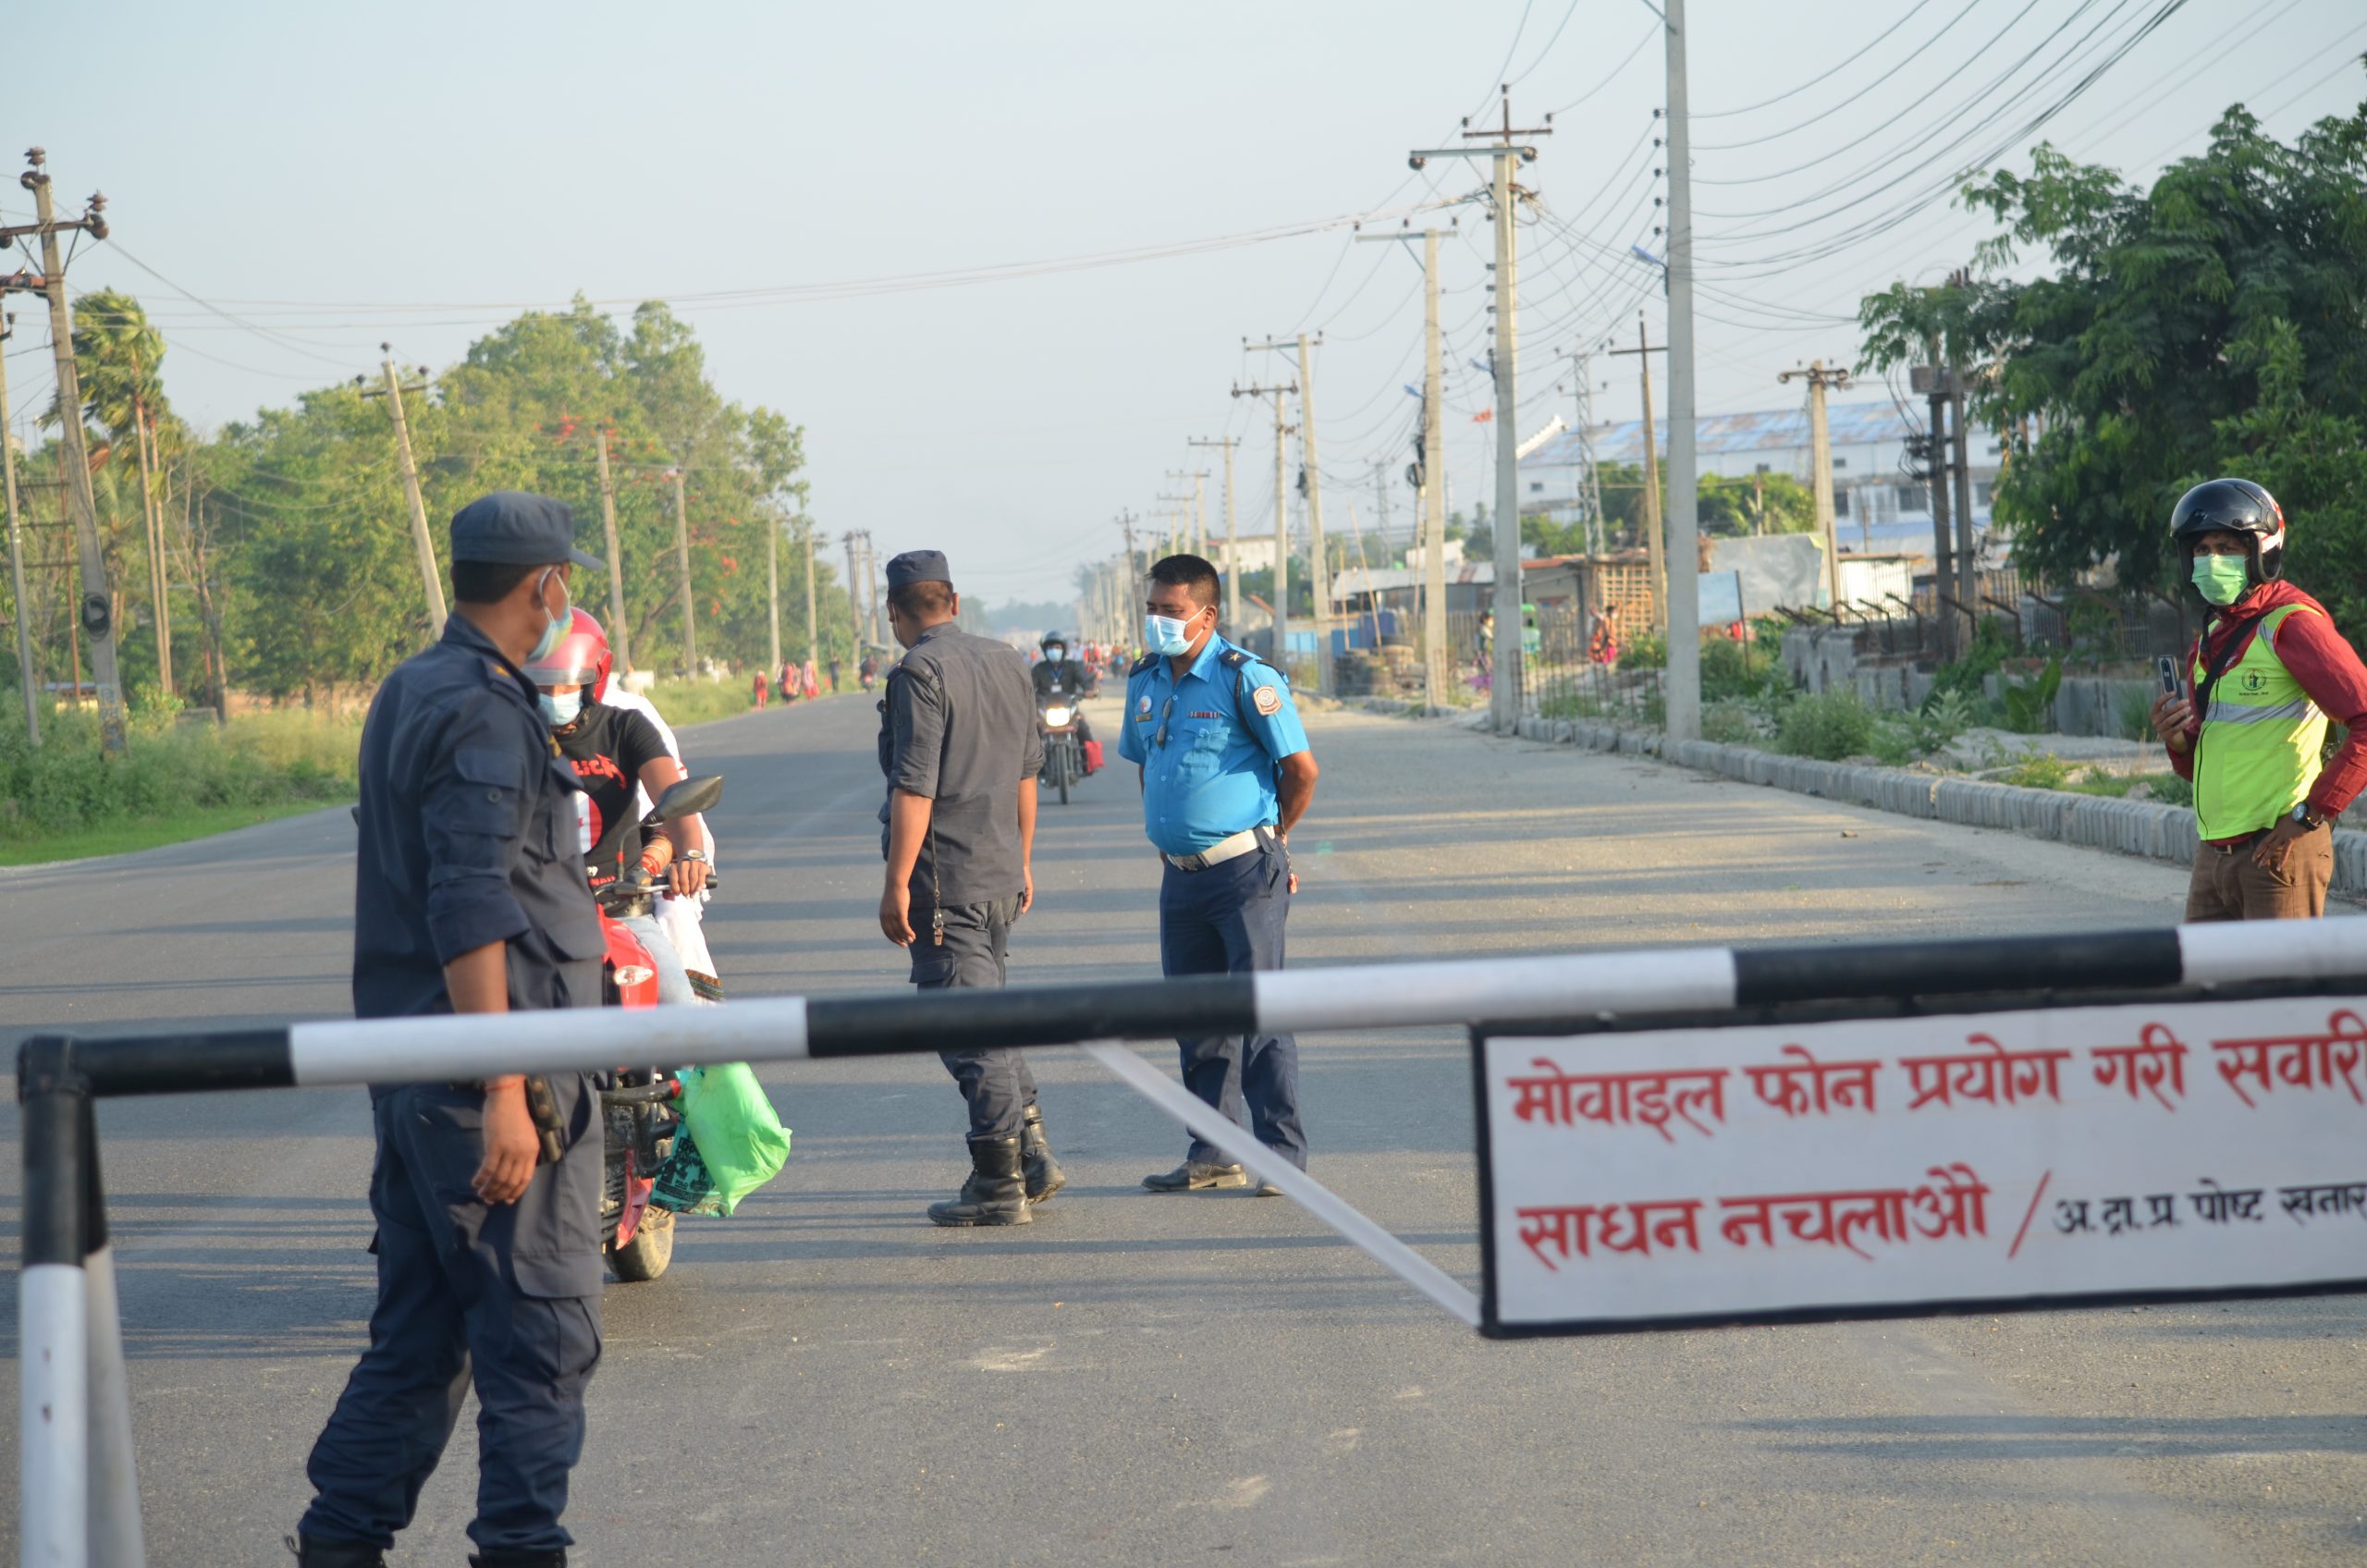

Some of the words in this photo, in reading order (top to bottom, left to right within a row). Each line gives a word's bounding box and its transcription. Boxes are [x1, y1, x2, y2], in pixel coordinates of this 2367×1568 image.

[1506, 1057, 1732, 1143] मोवाइल
[1743, 1044, 1883, 1117] फोन
[1898, 1033, 2073, 1111] प्रयोग
[2089, 1022, 2189, 1112] गरी
[1515, 1196, 1704, 1272] साधन
